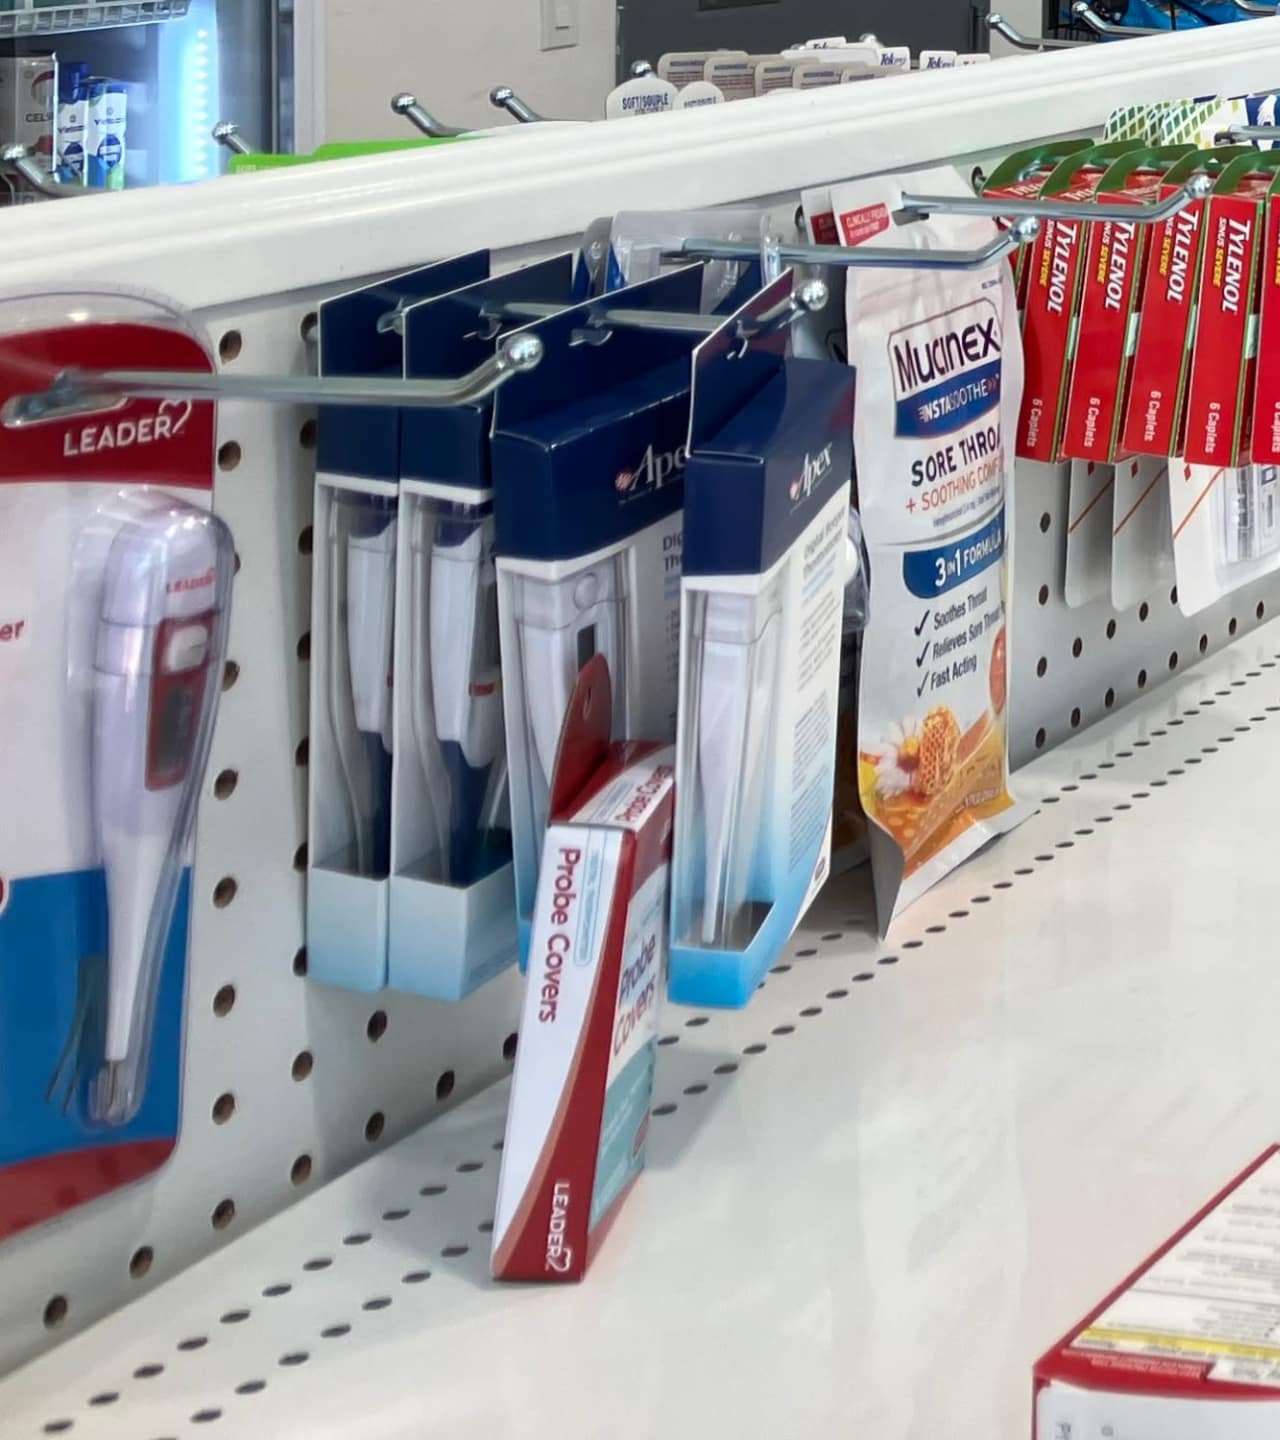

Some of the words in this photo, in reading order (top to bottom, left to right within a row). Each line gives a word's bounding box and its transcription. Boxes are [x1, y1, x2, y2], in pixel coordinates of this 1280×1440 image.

[1047, 221, 1078, 315] TYLENOL
[1105, 221, 1136, 310] TYLENOL
[1167, 209, 1199, 304] TYLENOL
[1222, 217, 1251, 314] TYLENOL
[894, 315, 1000, 393] Mucinex
[64, 416, 172, 456] LEADER
[1027, 407, 1042, 448] Caplets
[1084, 406, 1100, 448] Caplets
[1144, 399, 1161, 442] Caplets
[1205, 411, 1220, 454] Caplets
[796, 442, 833, 498] Apex
[911, 445, 957, 487] SORE
[921, 471, 976, 511] SOOTHING
[934, 603, 966, 630] Soothes
[932, 631, 967, 660] Relieves
[930, 667, 950, 690] Fast
[952, 654, 978, 681] Acting
[549, 846, 582, 927] Probe
[539, 931, 572, 1024] Covers
[544, 1183, 571, 1261] LEADER
